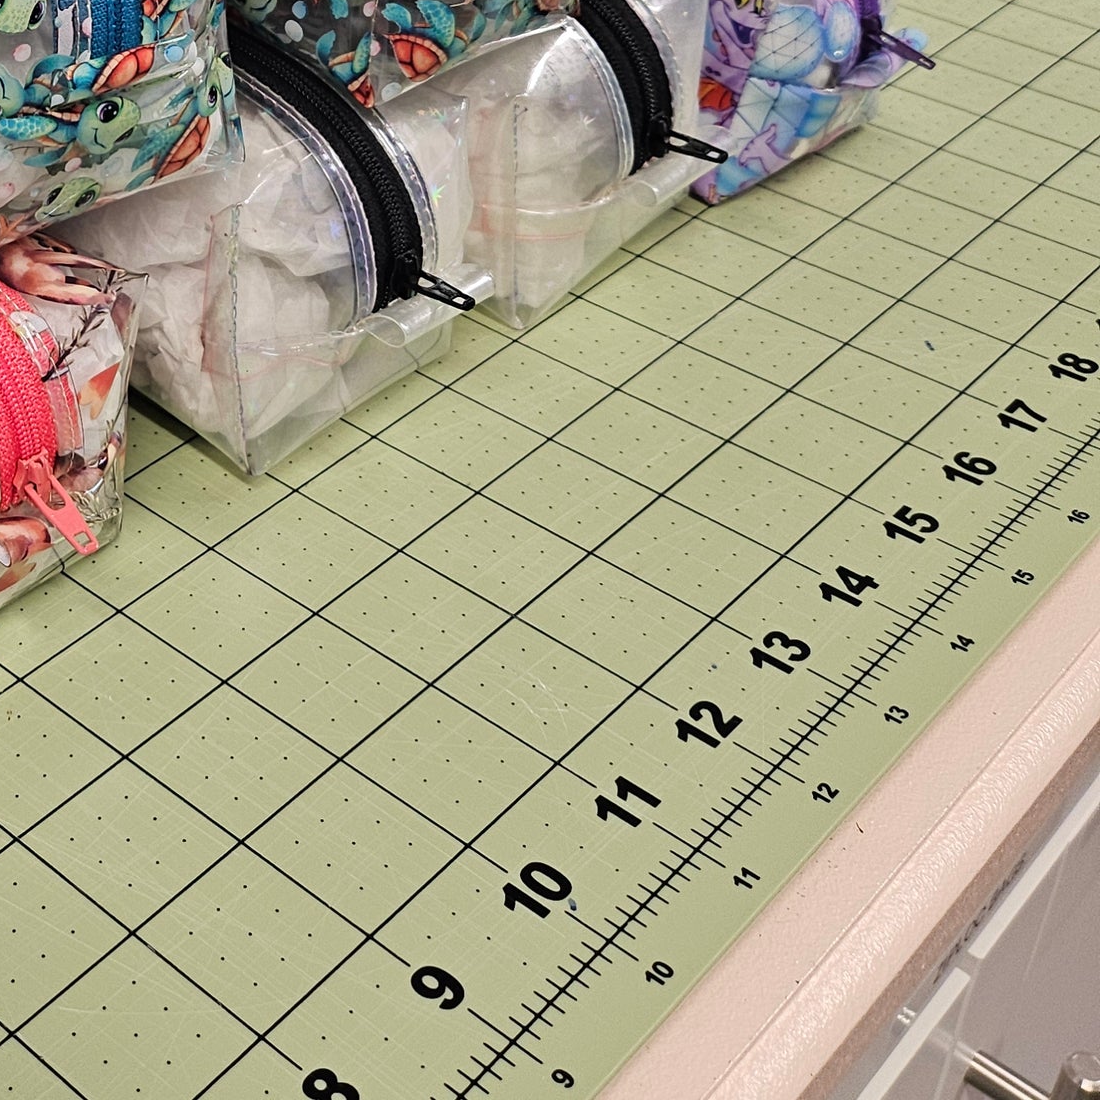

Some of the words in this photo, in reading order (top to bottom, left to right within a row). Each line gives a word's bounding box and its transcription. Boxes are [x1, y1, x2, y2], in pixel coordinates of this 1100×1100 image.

[301, 1068, 360, 1100] 8
[410, 965, 465, 1010] 9
[502, 861, 573, 919] 10
[594, 775, 662, 828] 11
[674, 700, 744, 749] 12
[749, 631, 811, 675] 13
[818, 565, 880, 608] 14
[882, 505, 940, 544] 15
[942, 451, 997, 486] 16
[997, 398, 1048, 433] 17
[1048, 352, 1100, 382] 18
[550, 1068, 575, 1089] 9
[644, 961, 675, 986] 10
[732, 866, 761, 890] 11
[811, 782, 840, 804] 12
[883, 705, 910, 725] 13
[949, 634, 975, 653] 14
[1010, 568, 1035, 586] 15
[1066, 509, 1091, 524] 16
